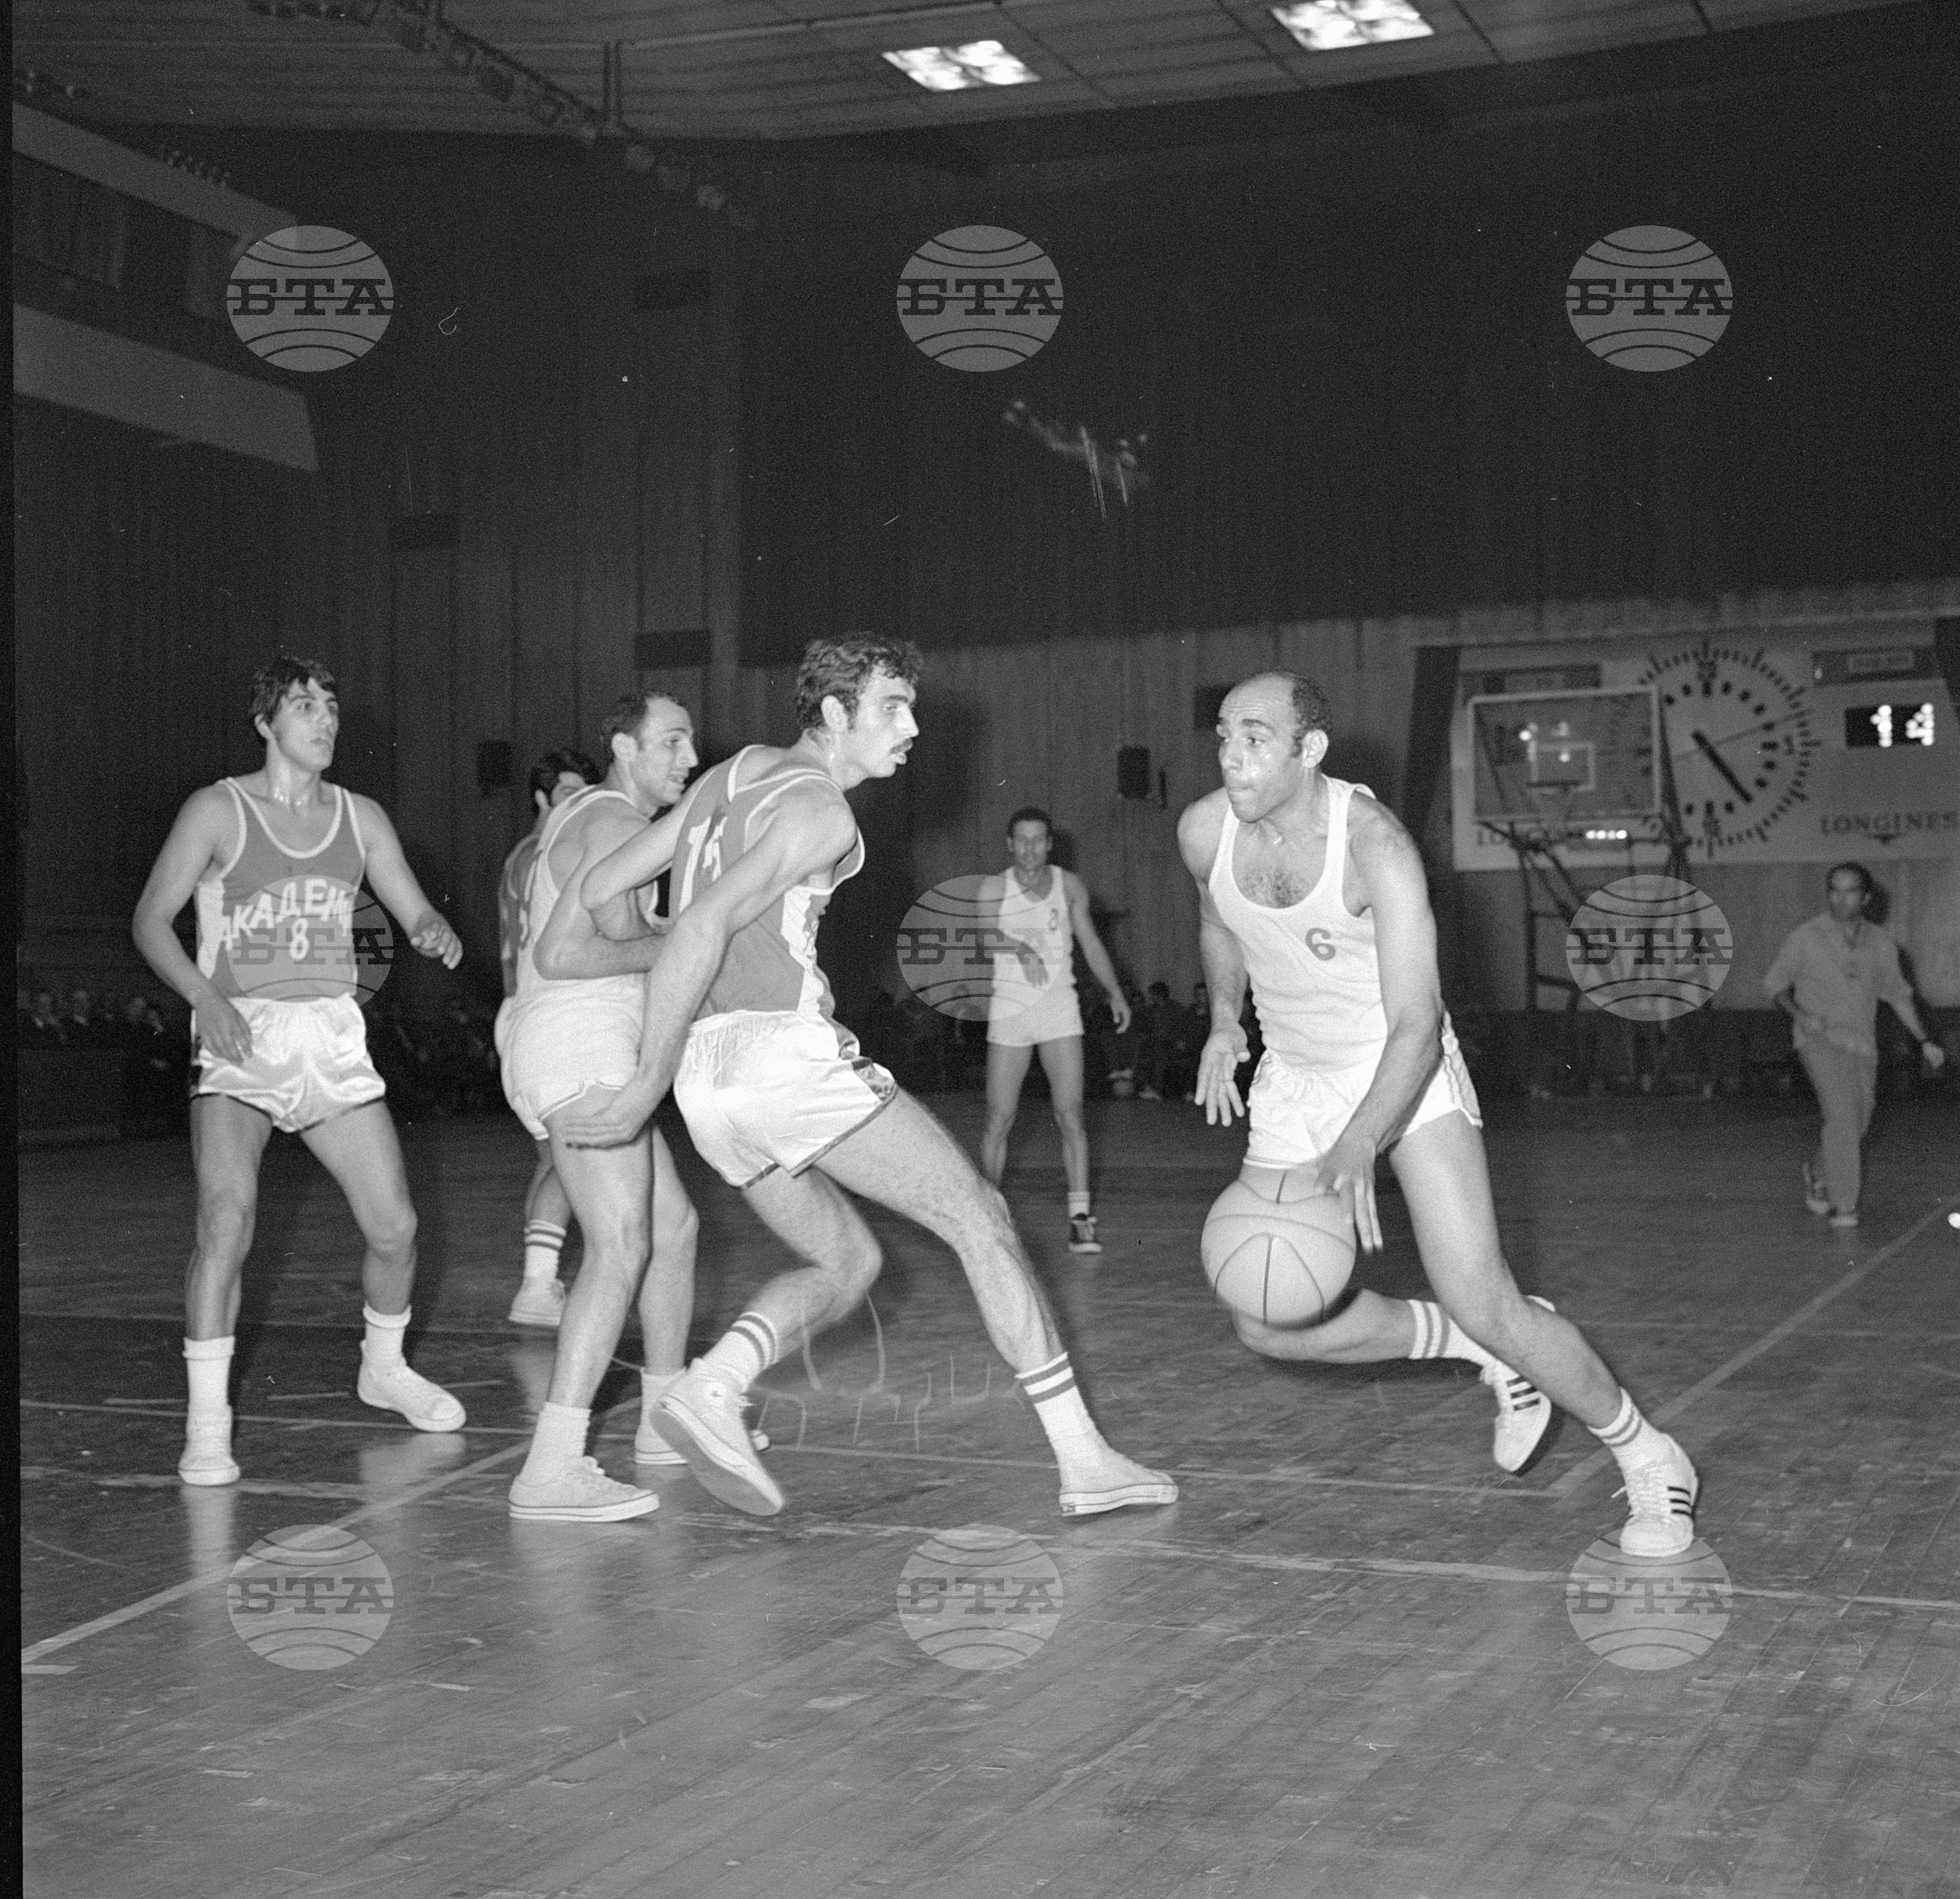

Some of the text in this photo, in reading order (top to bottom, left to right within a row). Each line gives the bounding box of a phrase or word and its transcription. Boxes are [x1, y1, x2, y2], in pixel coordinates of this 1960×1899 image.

[1870, 703, 1934, 747] 14
[290, 918, 309, 961] 8
[1305, 927, 1336, 961] 6
